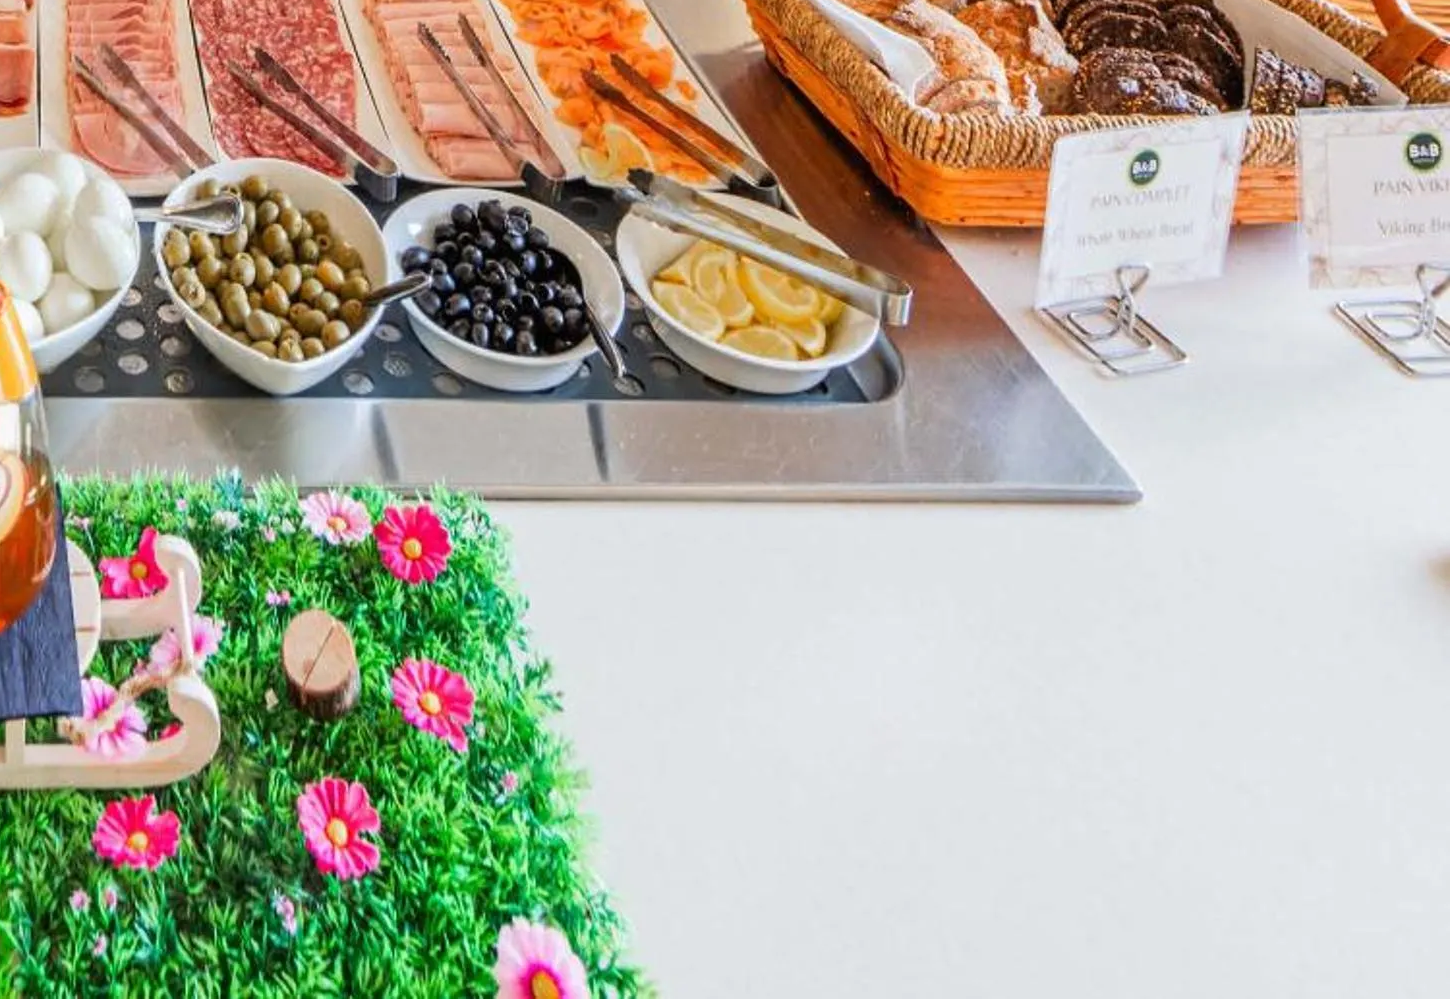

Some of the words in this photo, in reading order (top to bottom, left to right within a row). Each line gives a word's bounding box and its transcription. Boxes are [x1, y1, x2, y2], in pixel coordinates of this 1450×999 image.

[1409, 143, 1440, 159] B&B
[1374, 180, 1412, 196] PAIN
[1376, 218, 1426, 237] Viking
